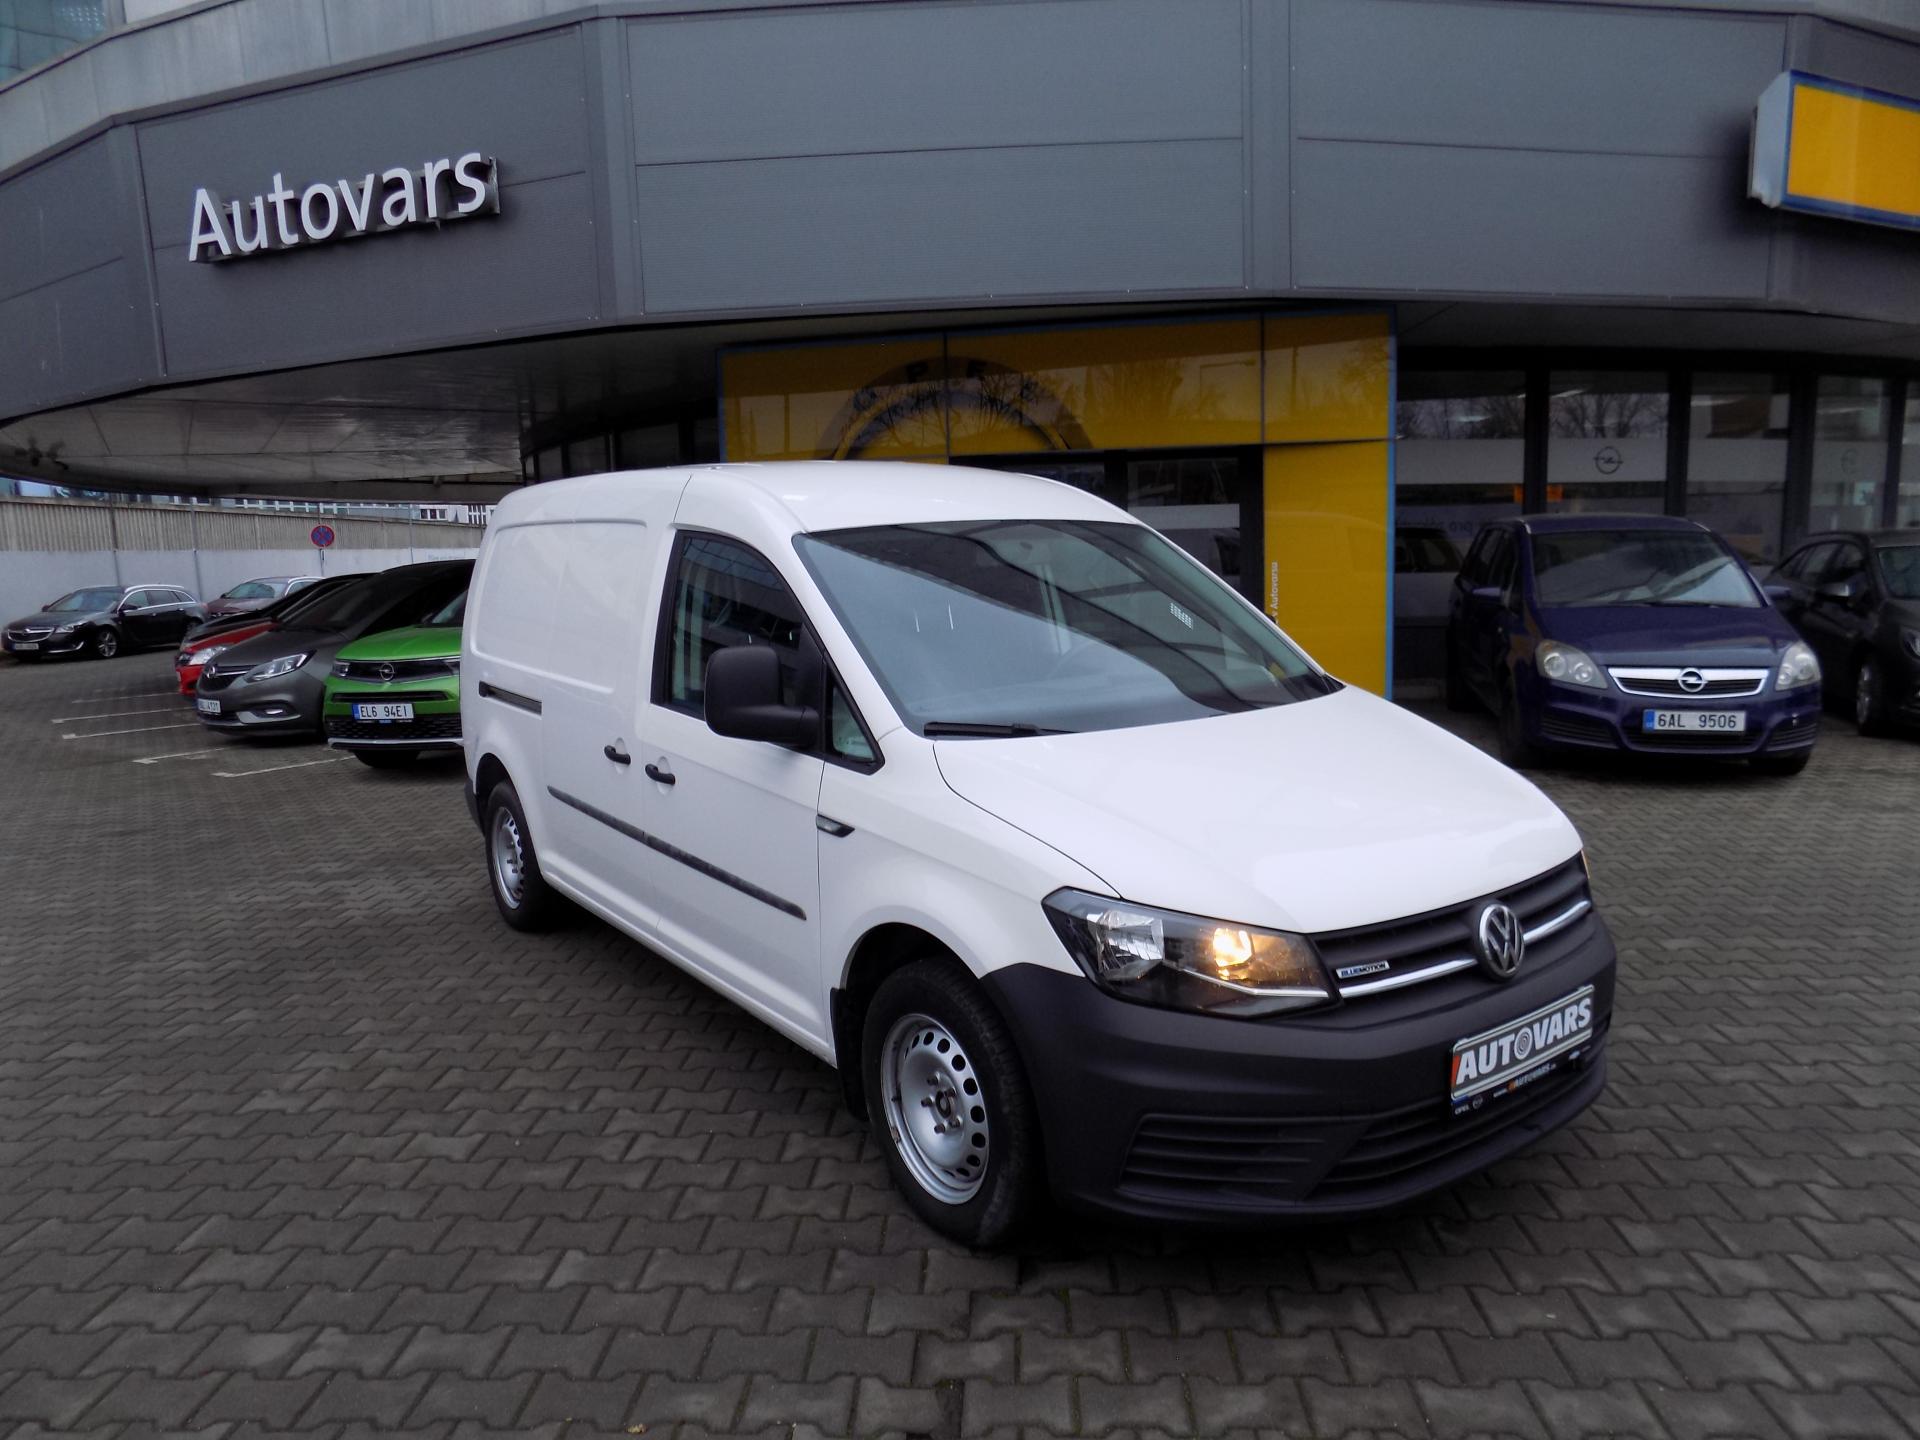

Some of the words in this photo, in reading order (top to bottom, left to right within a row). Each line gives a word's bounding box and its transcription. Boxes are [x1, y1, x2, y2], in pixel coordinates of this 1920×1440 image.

[188, 152, 487, 262] Autovars
[360, 706, 378, 718] EL6
[1658, 713, 1686, 728] 6AL
[1698, 714, 1737, 728] 9506
[1340, 961, 1387, 977] BLUEMOTION
[1455, 997, 1592, 1086] AUTOVARS
